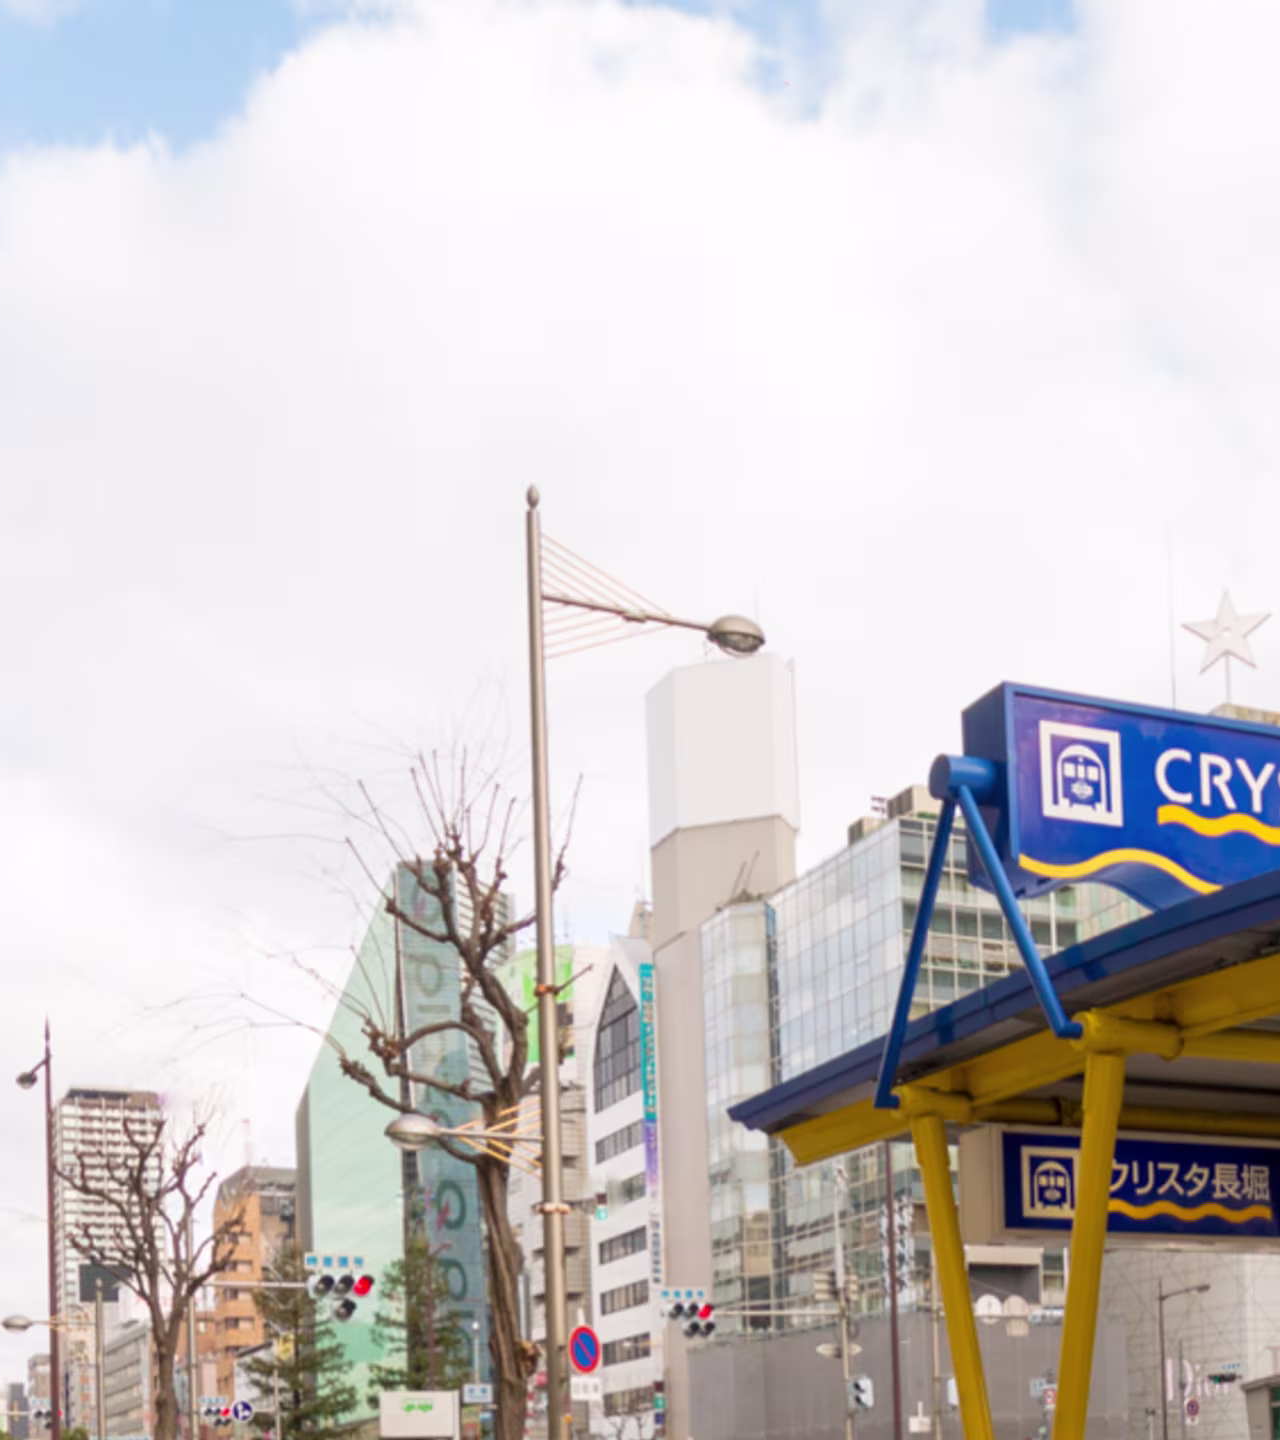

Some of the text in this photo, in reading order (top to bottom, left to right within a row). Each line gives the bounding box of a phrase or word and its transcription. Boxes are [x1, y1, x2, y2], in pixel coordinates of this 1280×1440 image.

[1109, 1158, 1271, 1202] クリスタ長堀
